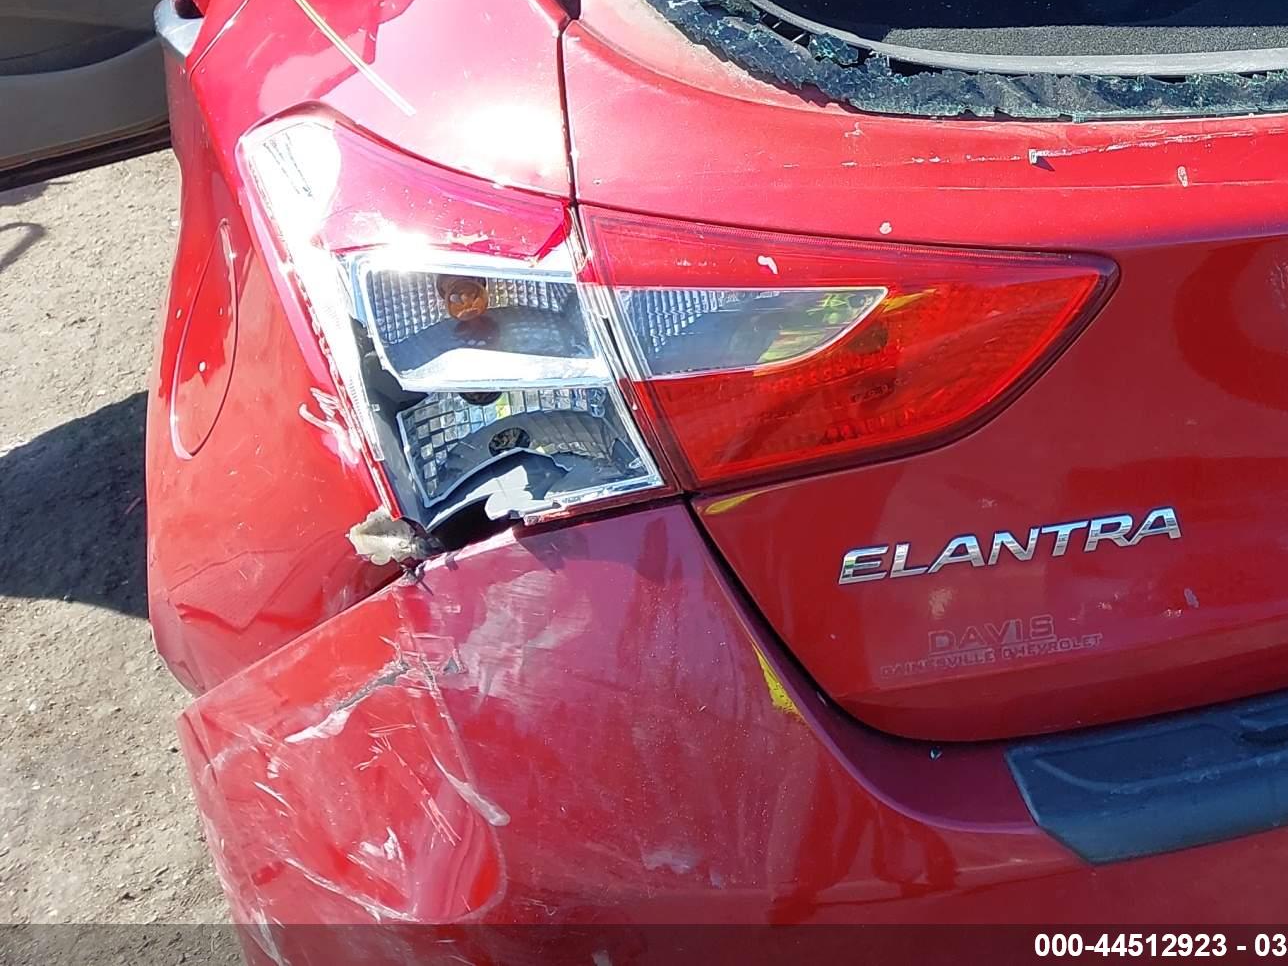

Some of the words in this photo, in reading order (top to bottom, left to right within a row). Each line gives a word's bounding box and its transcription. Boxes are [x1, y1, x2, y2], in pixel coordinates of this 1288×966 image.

[838, 505, 1183, 585] ELANTRA
[927, 614, 1055, 653] DAVIS
[1001, 632, 1104, 661] CHEVROLET
